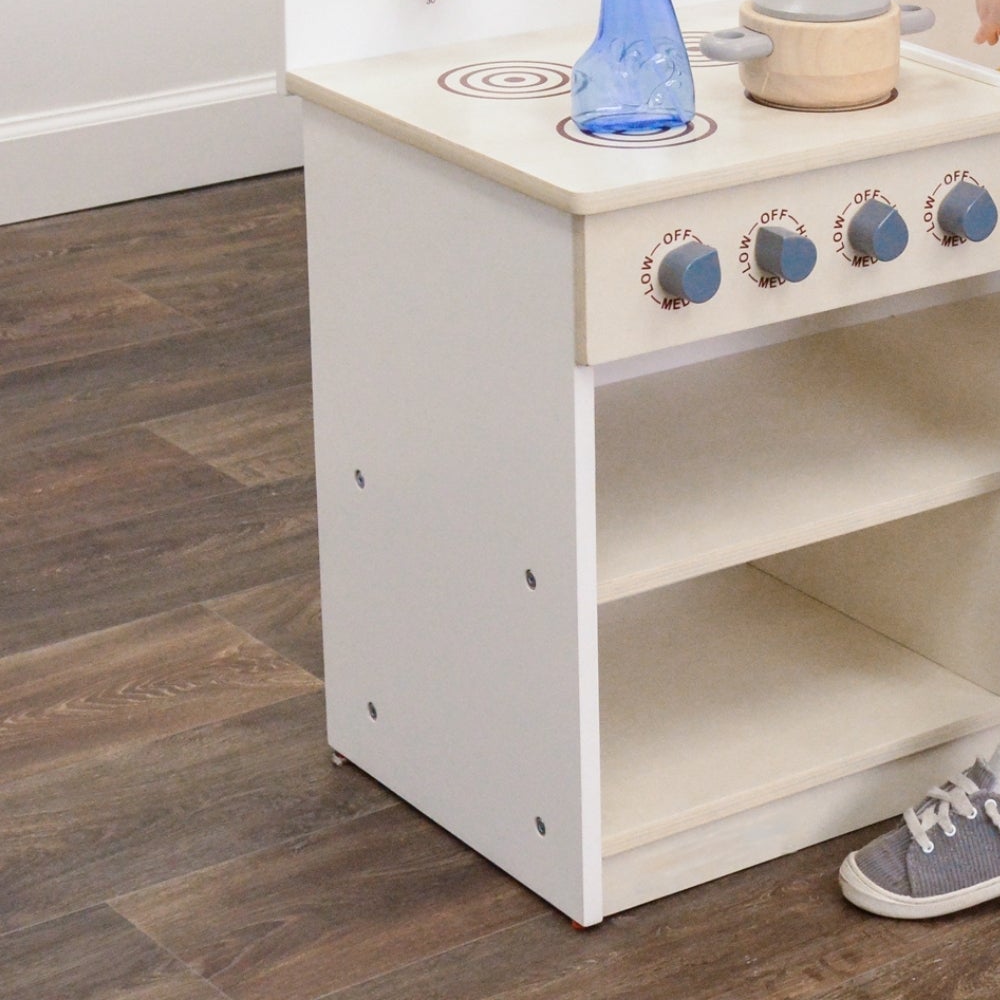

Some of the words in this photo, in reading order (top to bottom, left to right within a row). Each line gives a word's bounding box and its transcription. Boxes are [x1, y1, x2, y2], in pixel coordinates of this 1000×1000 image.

[944, 170, 970, 185] OFF
[854, 189, 881, 205] OFF
[760, 209, 788, 224] OFF
[923, 196, 935, 233] LOW
[663, 229, 692, 245] OFF
[832, 215, 845, 253] LOW
[738, 235, 752, 274] LOW
[641, 256, 654, 295] LOW
